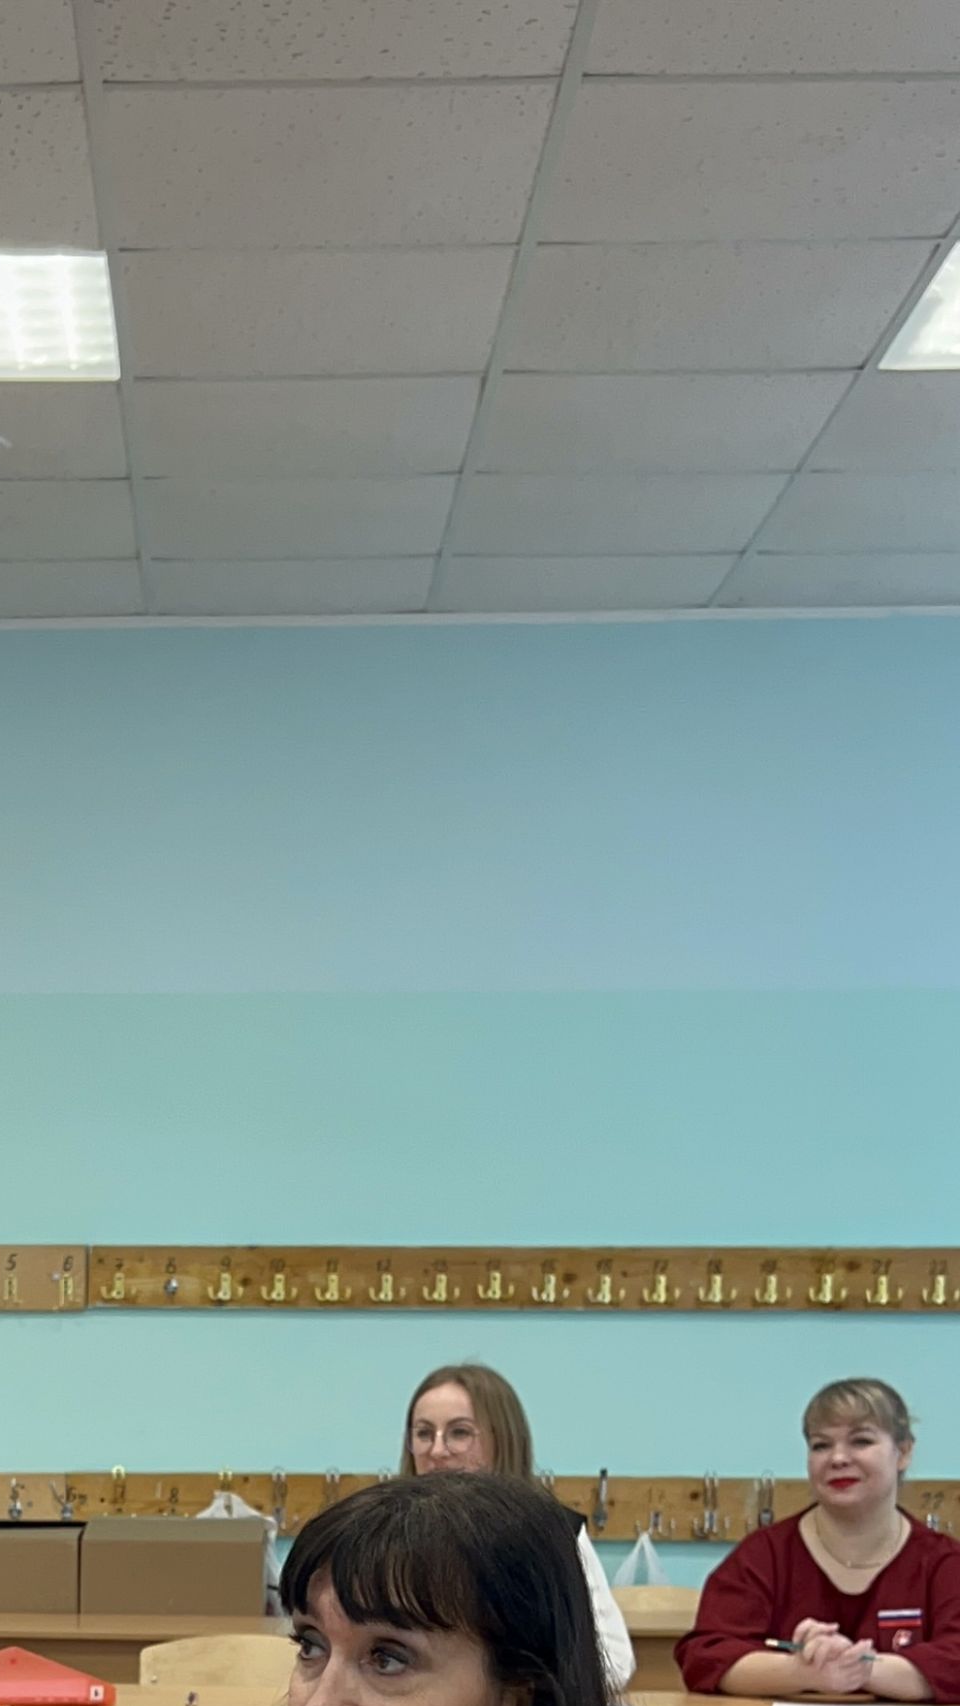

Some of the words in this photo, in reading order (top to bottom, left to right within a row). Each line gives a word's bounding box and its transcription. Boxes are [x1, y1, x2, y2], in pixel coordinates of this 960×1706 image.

[5, 1253, 18, 1271] 5
[63, 1254, 73, 1271] 6
[168, 1487, 179, 1504] 8
